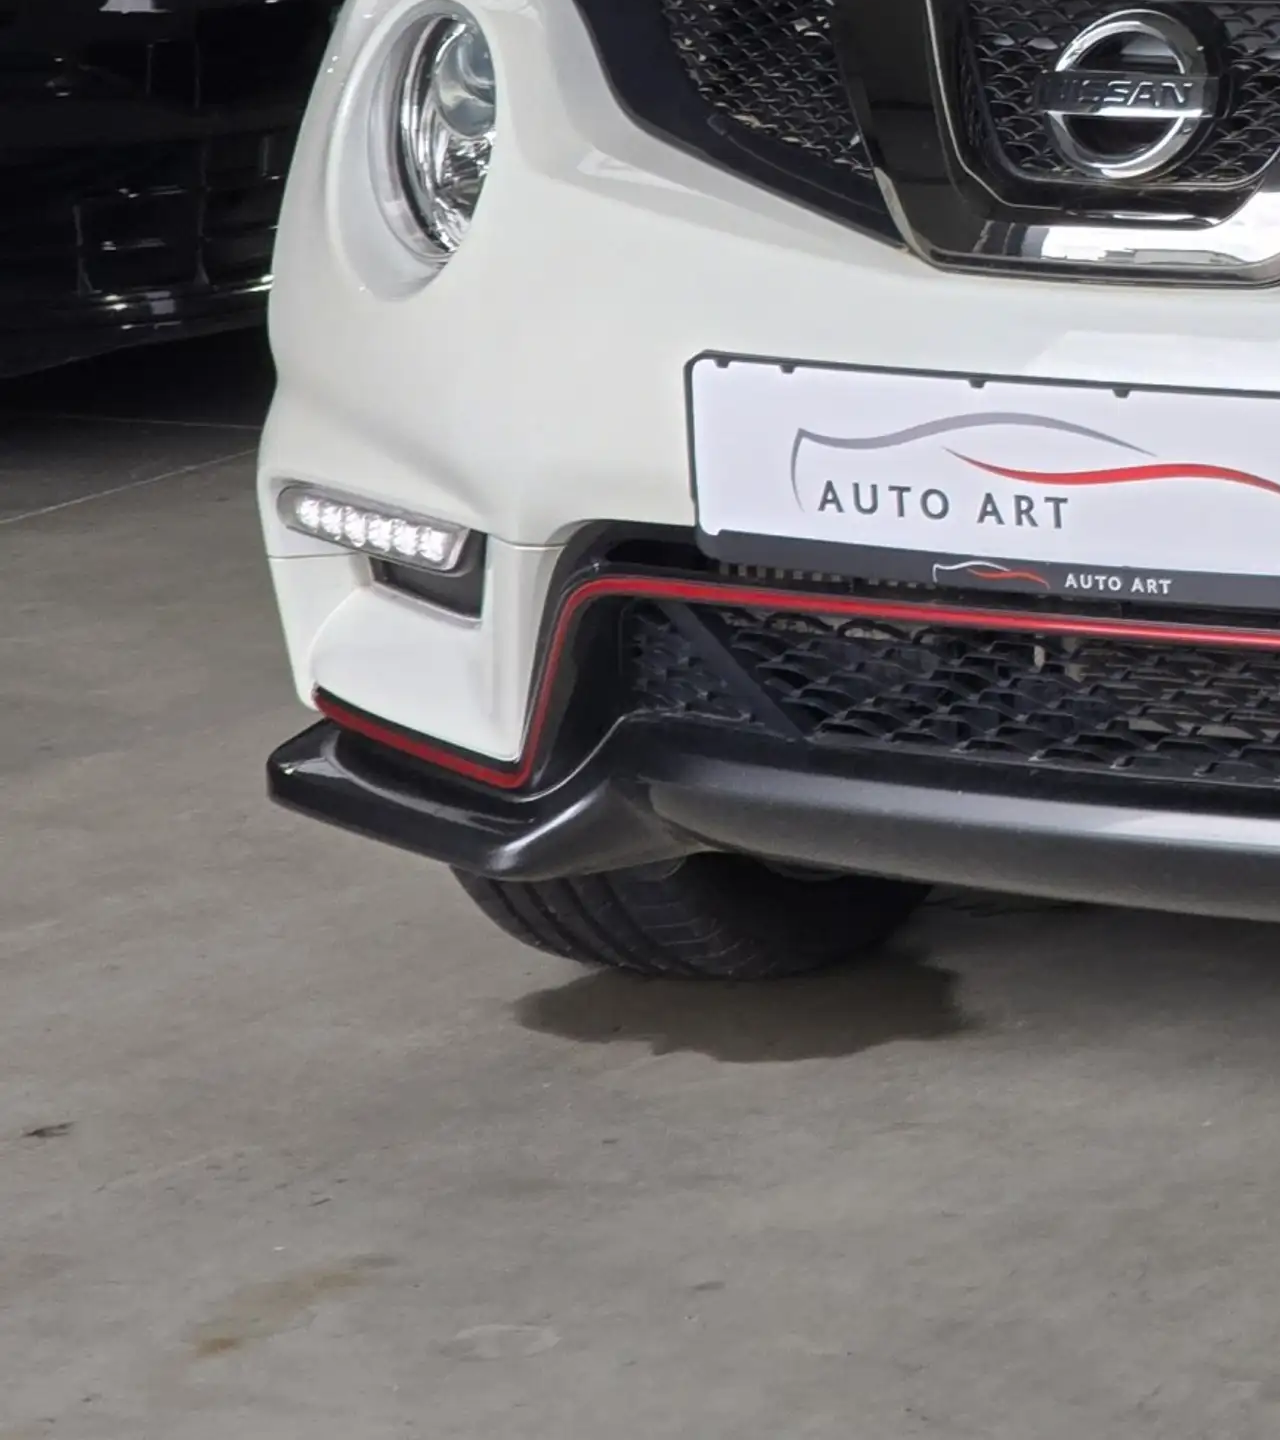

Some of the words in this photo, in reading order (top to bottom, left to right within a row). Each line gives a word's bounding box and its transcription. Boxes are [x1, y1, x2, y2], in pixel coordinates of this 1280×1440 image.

[1041, 78, 1194, 107] NISSAN
[818, 480, 950, 520] AUTO
[977, 492, 1069, 529] ART
[1064, 573, 1122, 591] AUTO
[1130, 576, 1172, 594] ART
